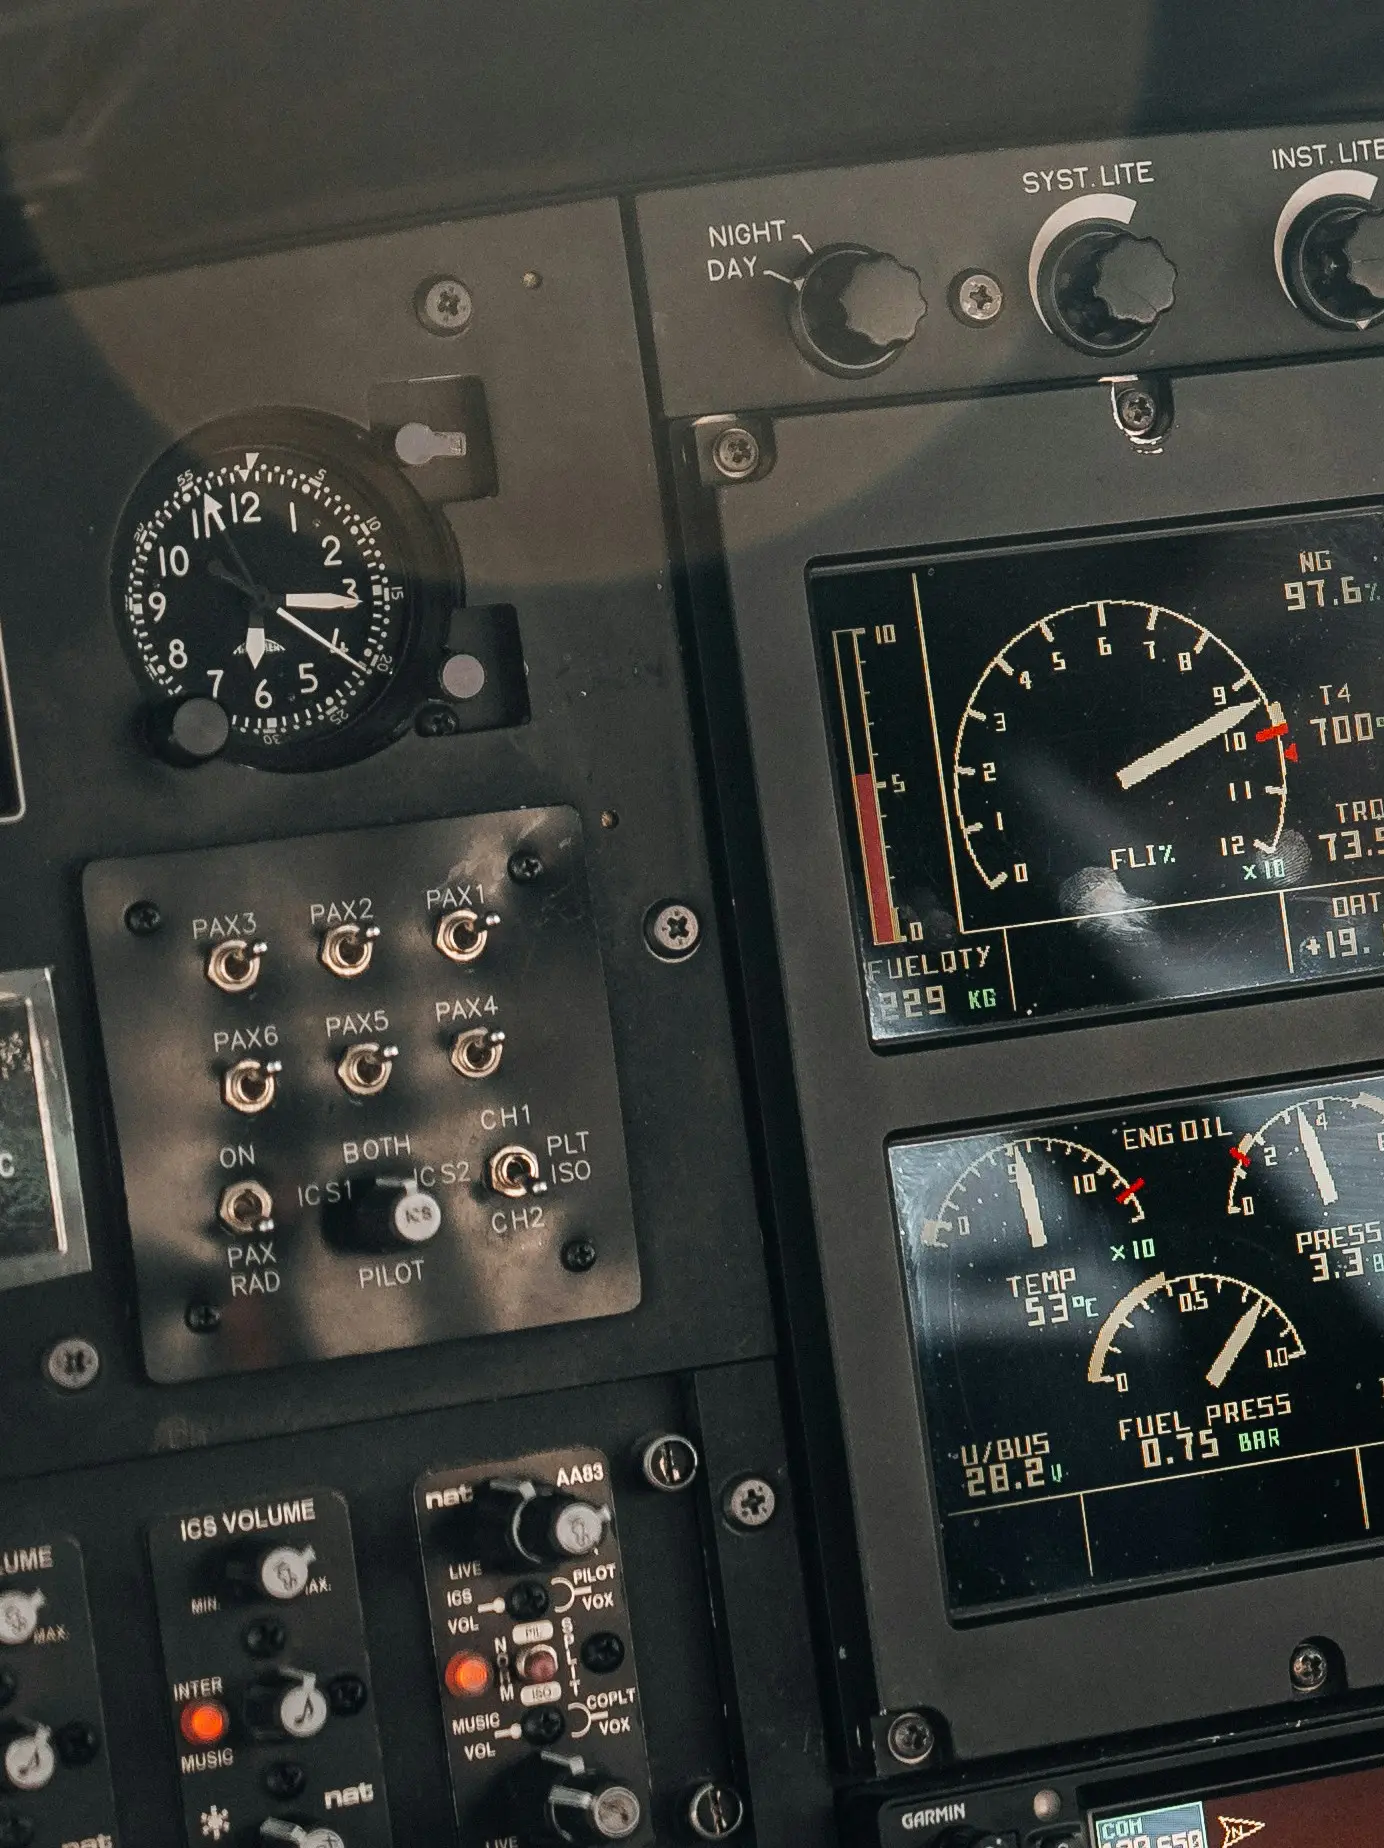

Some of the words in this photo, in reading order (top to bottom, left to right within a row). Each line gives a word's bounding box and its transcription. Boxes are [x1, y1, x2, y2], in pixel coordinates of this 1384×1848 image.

[1272, 144, 1333, 170] INST.
[1023, 167, 1096, 194] SYST.
[1100, 160, 1155, 186] LITE
[708, 220, 786, 248] NIGHT
[707, 258, 758, 284] DAY
[231, 492, 262, 522] 12
[290, 502, 297, 533] 1
[159, 546, 189, 577] 10
[321, 536, 342, 566] 2
[1300, 550, 1332, 572] NG
[148, 592, 167, 622] 9
[875, 623, 896, 644] 10
[168, 639, 188, 669] 8
[1099, 637, 1112, 656] 6
[1143, 640, 1157, 660] 7
[1052, 651, 1066, 671] 5
[1179, 652, 1192, 671] 8
[207, 670, 224, 699] 7
[299, 663, 318, 693] 5
[1019, 670, 1032, 690] 4
[255, 679, 272, 709] 6
[1214, 686, 1227, 705] 9
[1319, 683, 1352, 705] T4
[995, 712, 1007, 731] 3
[1224, 732, 1247, 752] 10
[892, 775, 906, 794] 5
[984, 763, 997, 782] 2
[1229, 781, 1252, 802] 11
[998, 812, 1004, 831] 1
[1336, 799, 1384, 822] TRQ
[1221, 836, 1245, 856] 12
[1013, 862, 1028, 883] 0
[426, 884, 486, 909] PAX1
[1333, 892, 1382, 919] OAT
[310, 898, 374, 924] PAX2
[192, 913, 258, 939] PAX3
[909, 922, 924, 941] 0
[435, 997, 499, 1023] PAX4
[969, 988, 998, 1011] KG
[325, 1010, 389, 1037] PAX5
[213, 1026, 279, 1053] PAX6
[481, 1104, 531, 1131] CH1
[547, 1131, 590, 1156] PLT
[1123, 1126, 1172, 1150] ENG
[1181, 1116, 1233, 1142] OIL
[219, 1144, 255, 1169] ON
[342, 1135, 412, 1164] BOTH
[1265, 1147, 1279, 1166] 2
[551, 1160, 591, 1185] ISO
[1074, 1174, 1097, 1194] 10
[1242, 1197, 1254, 1217] 0
[492, 1207, 545, 1233] CH2
[1296, 1221, 1382, 1254] PRESS
[227, 1244, 276, 1268] PAX
[230, 1271, 281, 1297] RAD
[359, 1260, 425, 1290] PILOT
[1006, 1267, 1076, 1298] TEMP
[1180, 1291, 1209, 1313] 0.5
[1266, 1347, 1288, 1369] 1.0
[1116, 1373, 1129, 1393] 0
[1119, 1412, 1191, 1441] FUEL
[1207, 1393, 1292, 1424] PRESS
[1143, 1429, 1219, 1469] 0.75
[1239, 1427, 1280, 1453] BAR
[425, 1484, 474, 1510] nat
[222, 1498, 315, 1534] VOLUME
[449, 1560, 482, 1580] LIVE
[573, 1563, 616, 1585] PILOT
[582, 1591, 614, 1612] VOX
[448, 1616, 479, 1635] VOL
[173, 1676, 222, 1702] INTER
[586, 1687, 636, 1711] COPLT
[452, 1713, 500, 1736] MUSIC
[599, 1716, 631, 1735] VOX
[181, 1748, 234, 1774] MUSIC
[464, 1741, 496, 1761] VOL
[324, 1782, 374, 1810] nat
[902, 1802, 966, 1830] GARMIN
